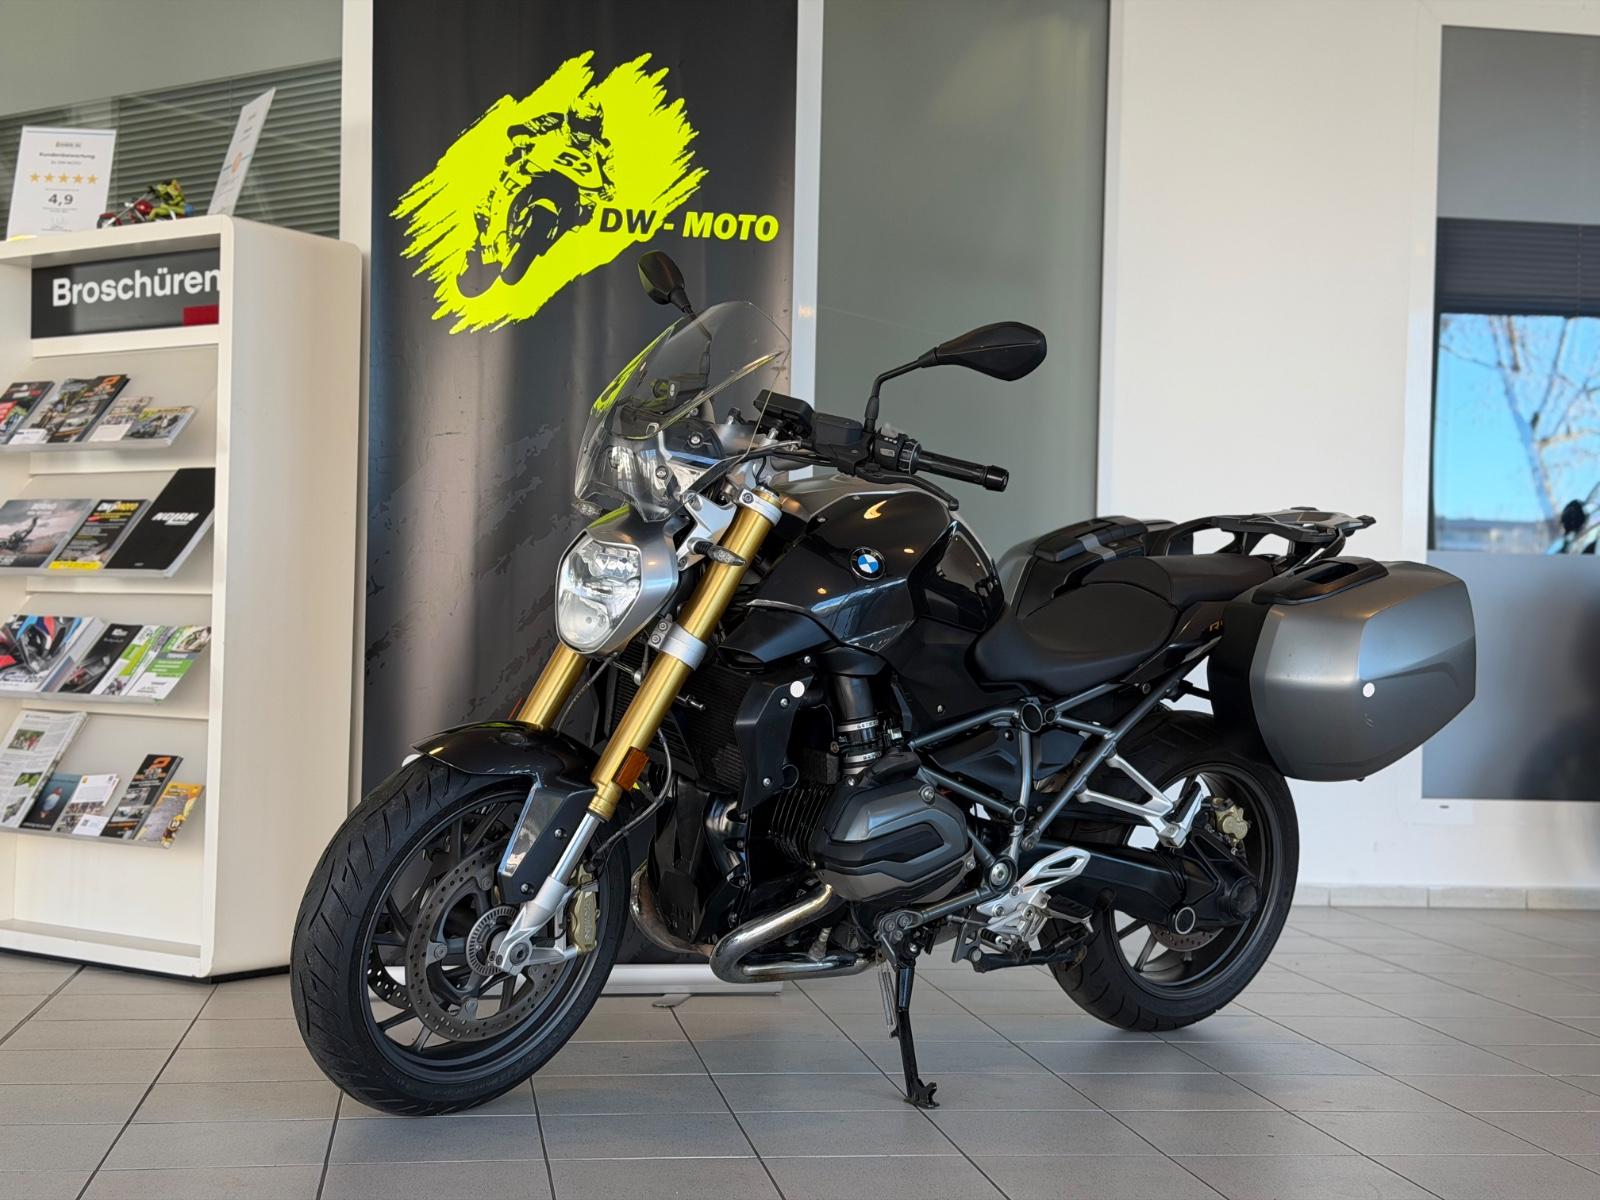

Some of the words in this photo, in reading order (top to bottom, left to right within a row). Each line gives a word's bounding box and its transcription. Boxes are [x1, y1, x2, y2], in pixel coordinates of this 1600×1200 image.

[553, 151, 593, 177] 52
[47, 193, 74, 207] 4,9
[599, 207, 657, 235] DW
[682, 211, 780, 243] MOTO
[52, 267, 220, 307] Broschüren
